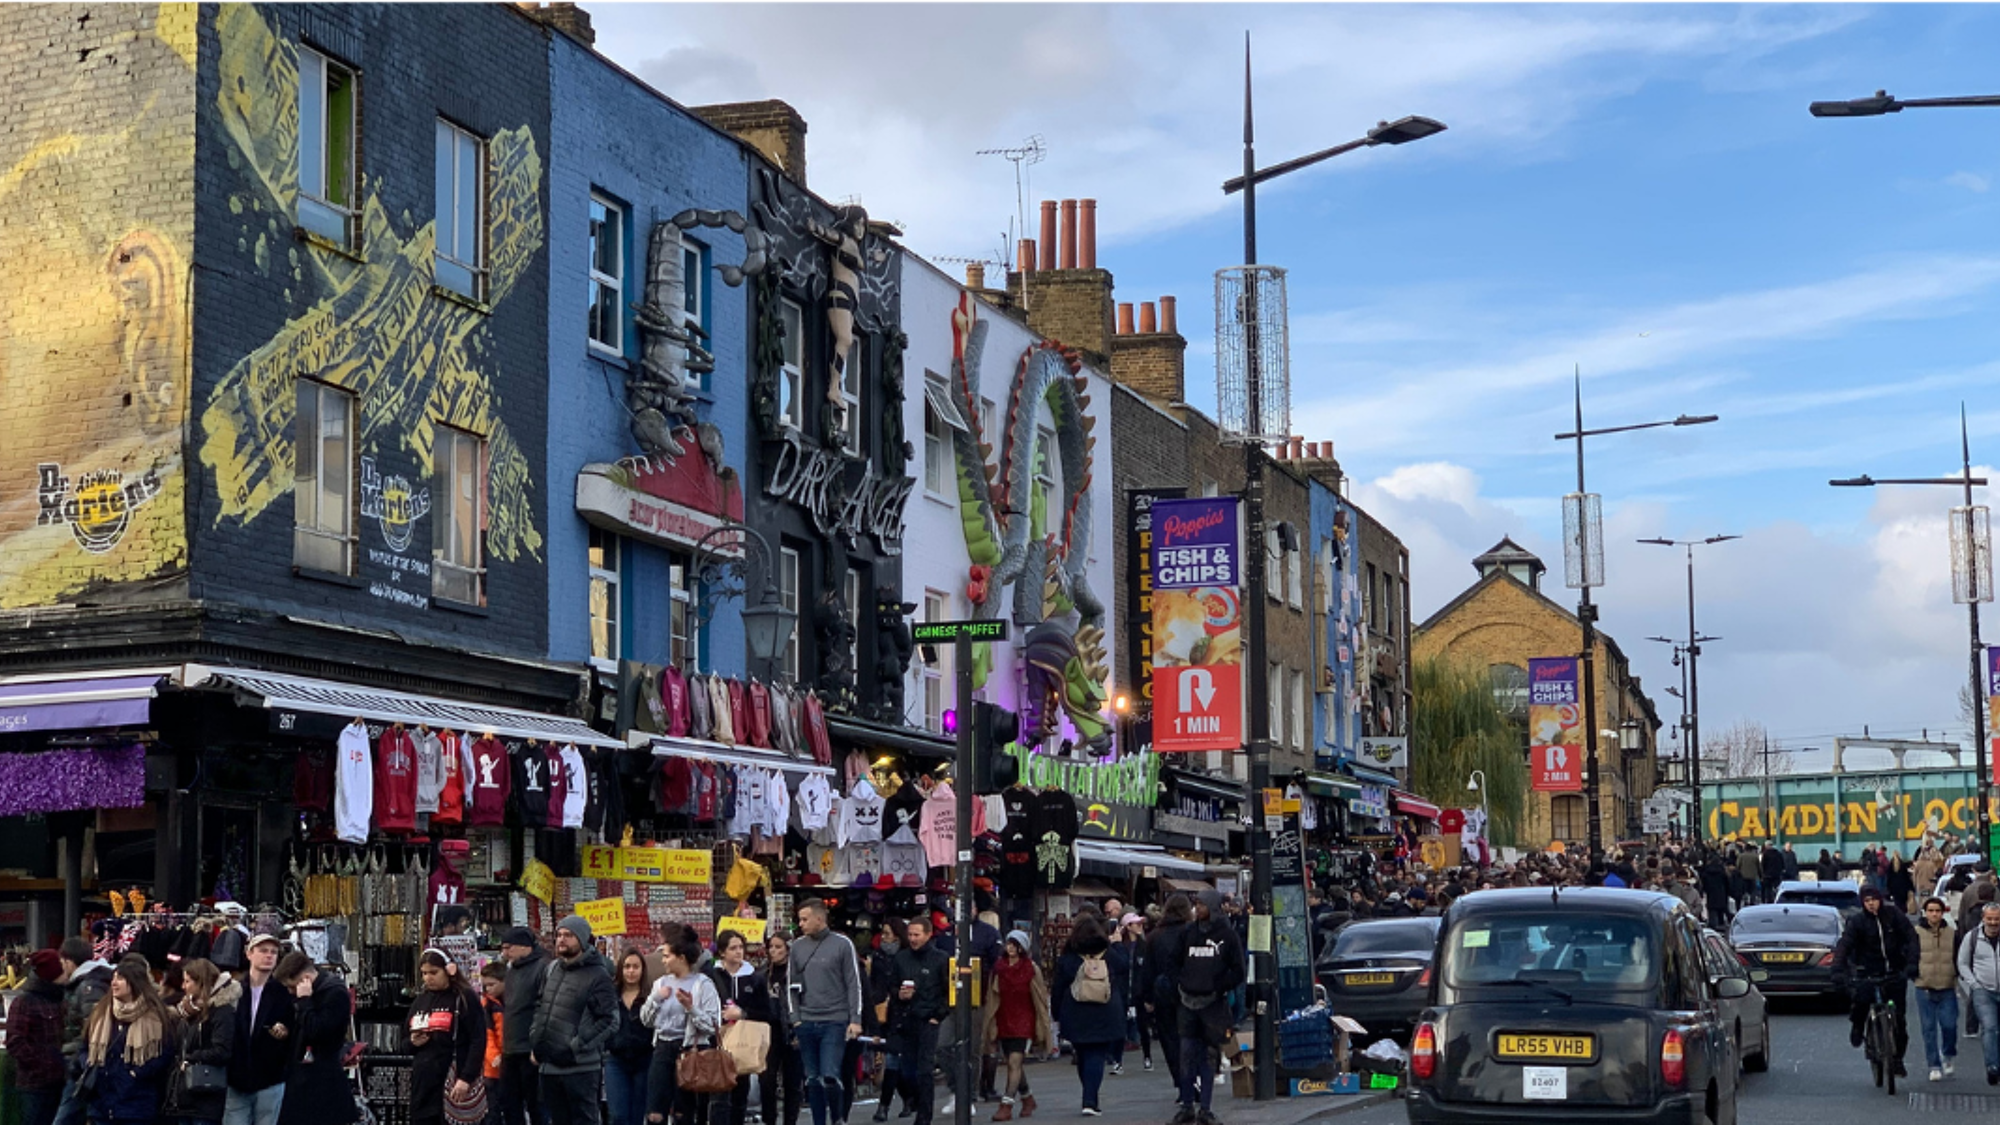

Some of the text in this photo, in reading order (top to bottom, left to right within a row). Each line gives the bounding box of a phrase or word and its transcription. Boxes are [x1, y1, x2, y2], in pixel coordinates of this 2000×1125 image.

[1164, 508, 1225, 546] Poppies
[1158, 547, 1231, 567] FISH &
[1158, 565, 1231, 584] CHIPS
[915, 625, 958, 638] CHINESE
[1532, 682, 1561, 693] FISH
[1533, 691, 1574, 703] CHIPS
[1174, 716, 1220, 735] 1 MIN
[1069, 762, 1093, 799] EAT
[1551, 771, 1571, 782] MIN
[1709, 801, 1879, 841] CAMDEN
[589, 848, 614, 869] £1
[668, 866, 706, 876] 6 for £5
[1505, 1038, 1584, 1055] LR55 VHB
